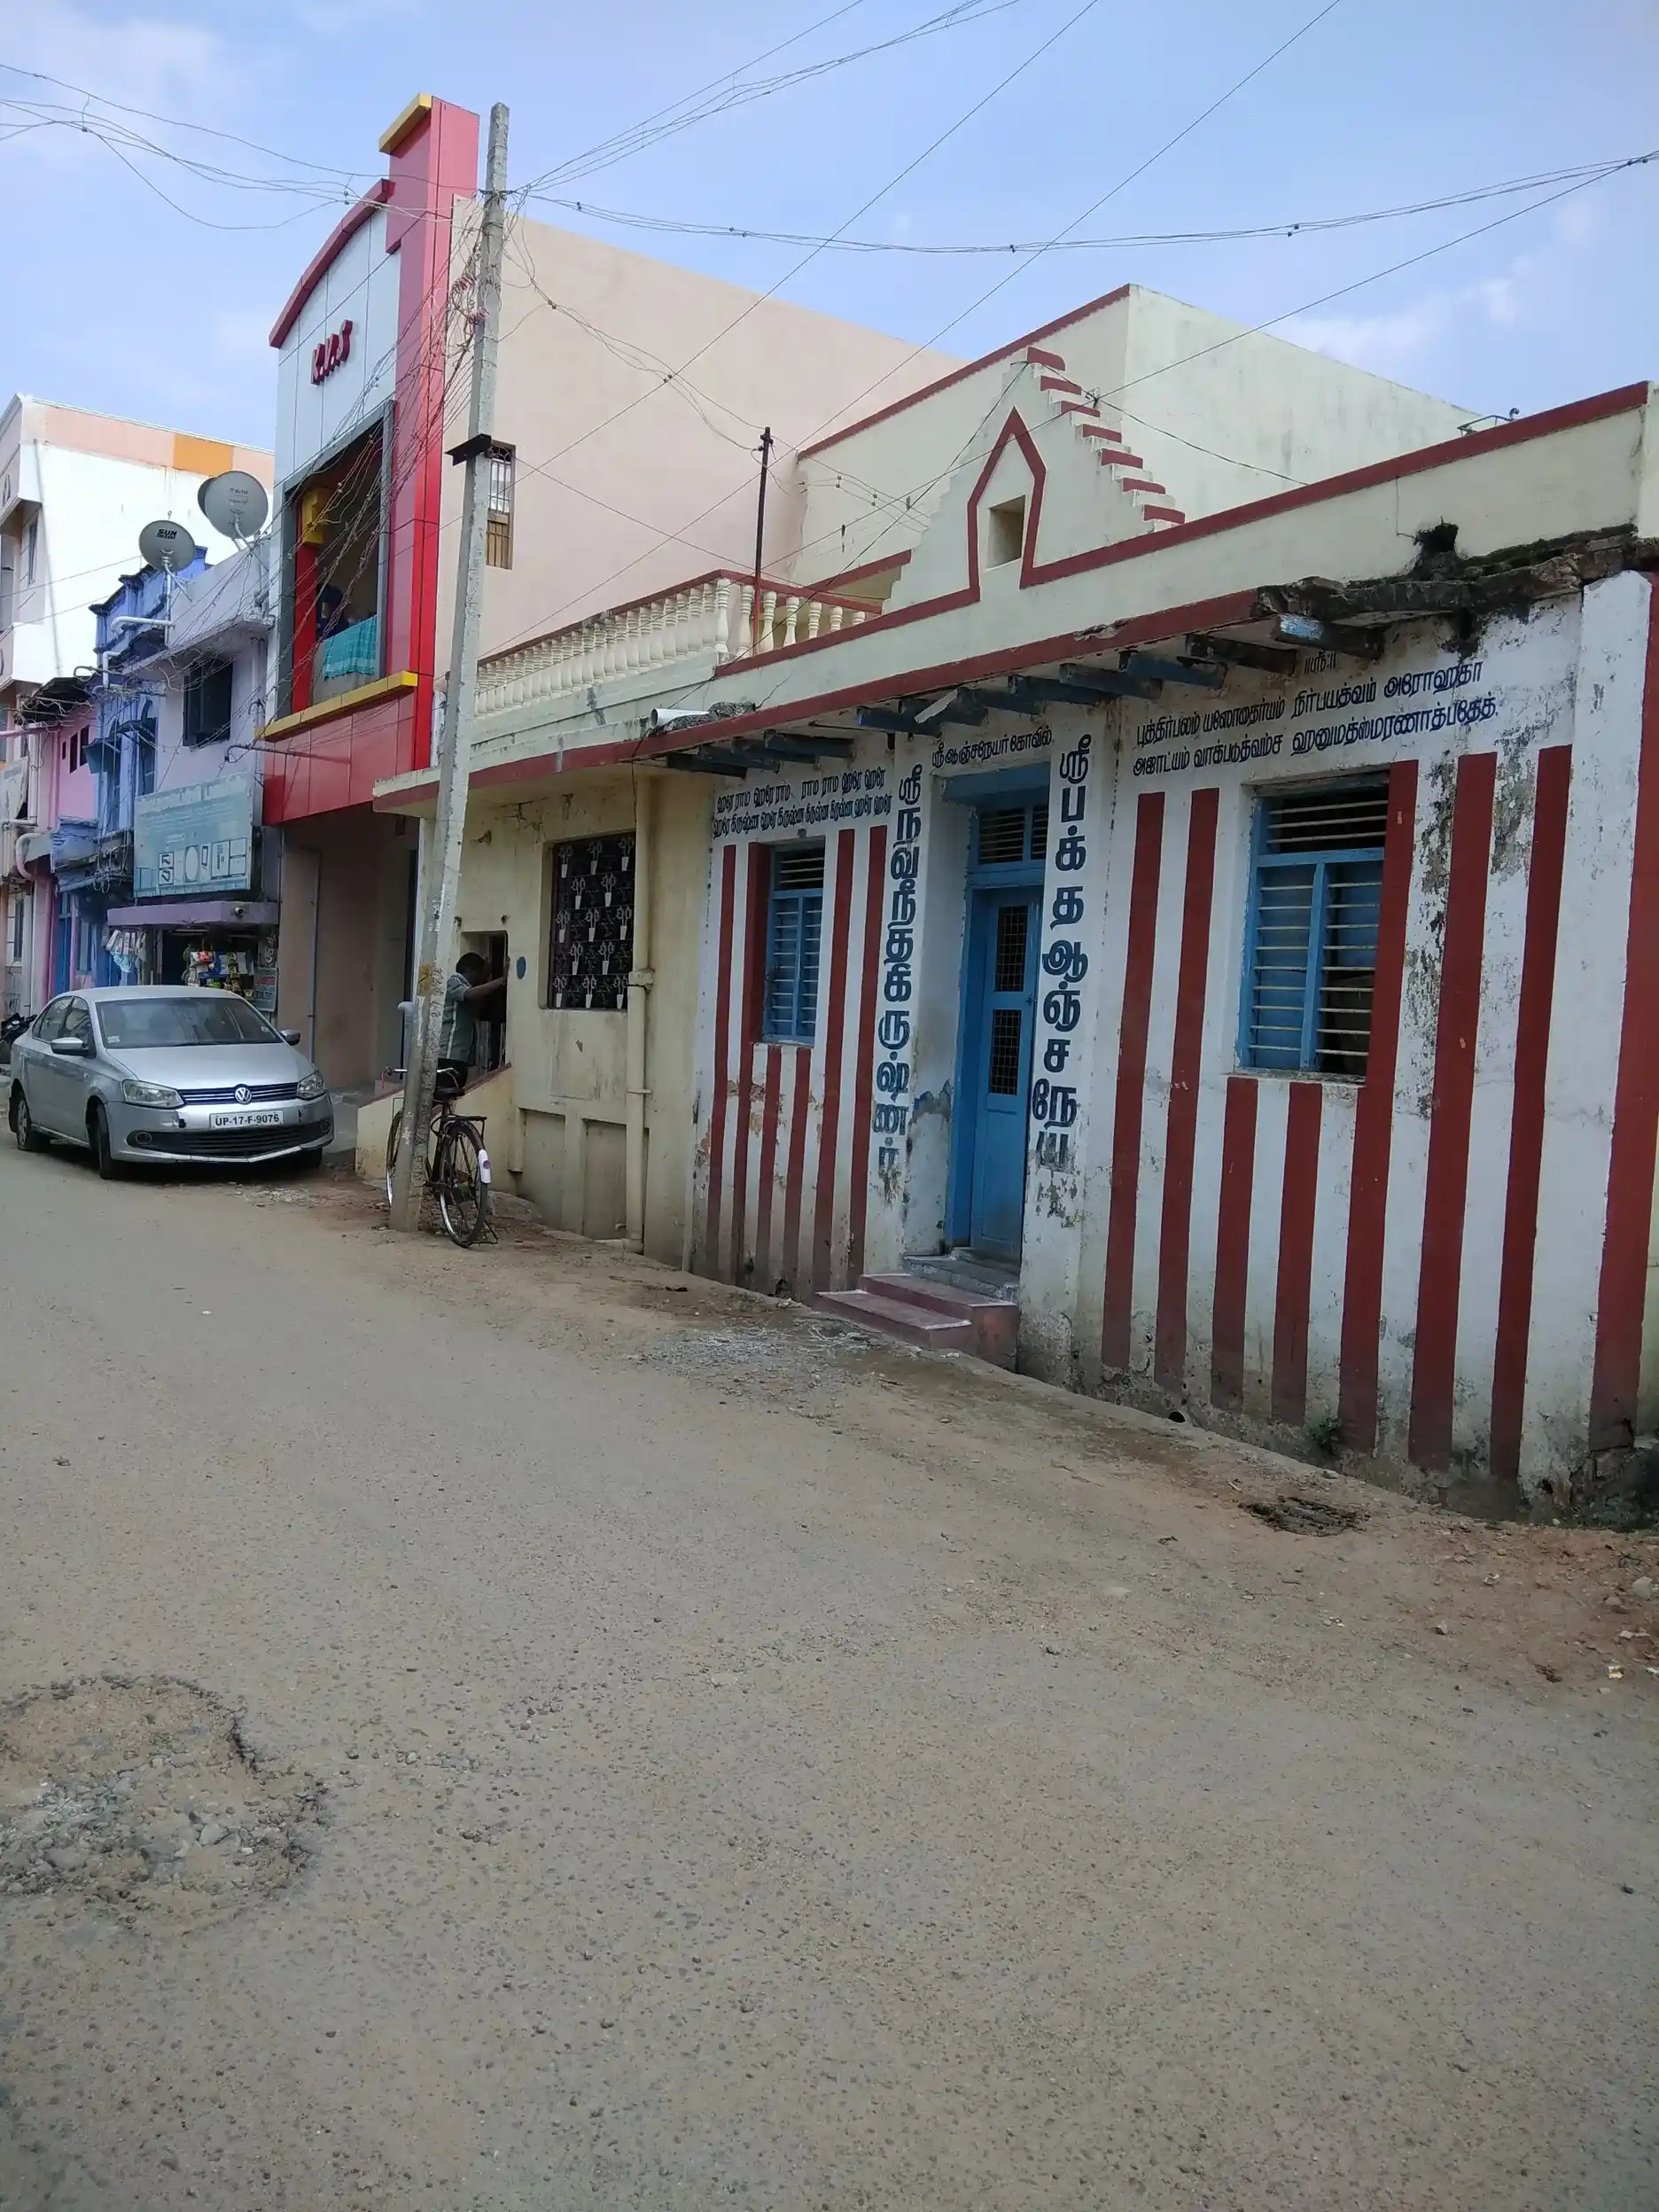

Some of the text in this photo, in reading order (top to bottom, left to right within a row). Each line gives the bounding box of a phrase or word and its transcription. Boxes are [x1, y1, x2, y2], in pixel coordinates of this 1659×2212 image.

[1290, 677, 1376, 720] நிர்பயத்வம்
[931, 725, 1053, 768] ஸ்ரீ ஆஞ்சநேயர் கோவில்
[1059, 734, 1092, 784] ஸ்ரீ
[735, 791, 752, 812] ராம
[775, 784, 791, 806] ராம
[801, 780, 820, 801] ராம
[822, 775, 839, 798] ராம
[899, 763, 923, 806] ஸ்ரீ
[215, 1113, 280, 1126] UP-17-F-9076
